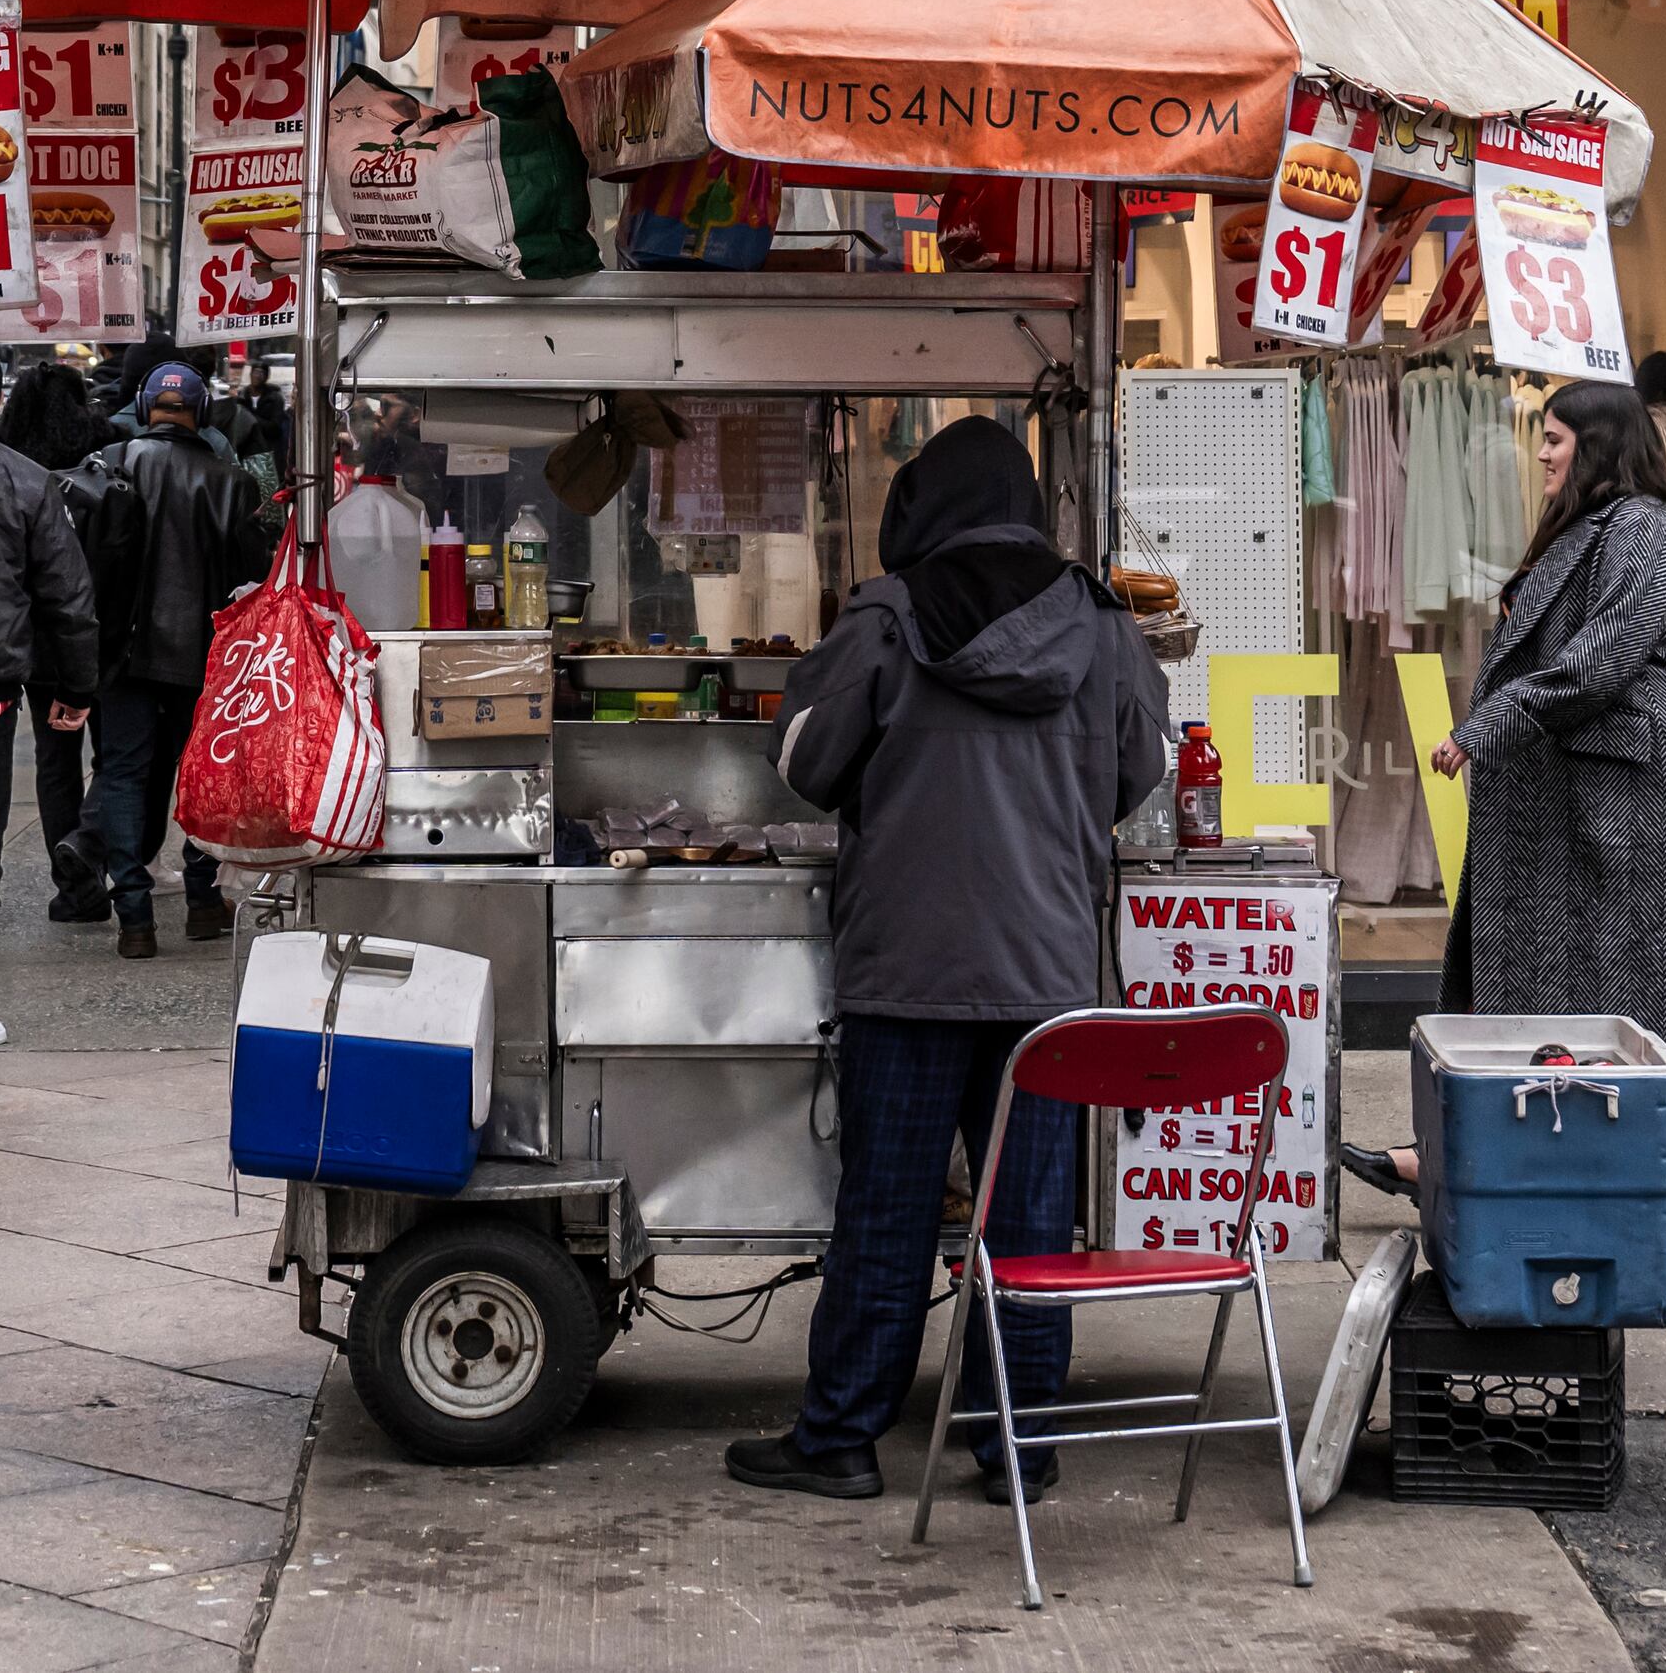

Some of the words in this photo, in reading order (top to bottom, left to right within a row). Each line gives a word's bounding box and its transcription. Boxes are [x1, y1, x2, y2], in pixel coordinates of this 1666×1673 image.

[97, 43, 124, 57] K+M
[96, 104, 128, 117] CHICKEN
[749, 78, 1241, 138] NUTS4NUTS.COM
[275, 120, 304, 134] BEE
[1481, 118, 1517, 151] HOT
[1519, 128, 1601, 170] SAUSAGE
[59, 145, 121, 181] DOG
[197, 159, 236, 190] HOT
[383, 190, 419, 202] MARKET
[350, 213, 380, 225] LARGEST
[379, 212, 421, 225] COLLECTION
[421, 212, 432, 224] OF
[355, 228, 386, 242] ETHNIC
[385, 228, 438, 242] PRODUCTS
[105, 252, 132, 266] K+M
[1270, 225, 1346, 309] $1
[1505, 244, 1593, 344] $3
[259, 311, 295, 326] BEEF
[1274, 309, 1289, 327] K+M
[1295, 313, 1326, 334] CHICKEN
[1254, 339, 1281, 353] K+M
[1584, 345, 1622, 372] BEEF
[1128, 896, 1297, 931] WATER
[1239, 944, 1294, 977] 1.50
[1126, 982, 1199, 1009] CAN
[1203, 982, 1298, 1018] SODA
[1122, 1167, 1192, 1201] CAN
